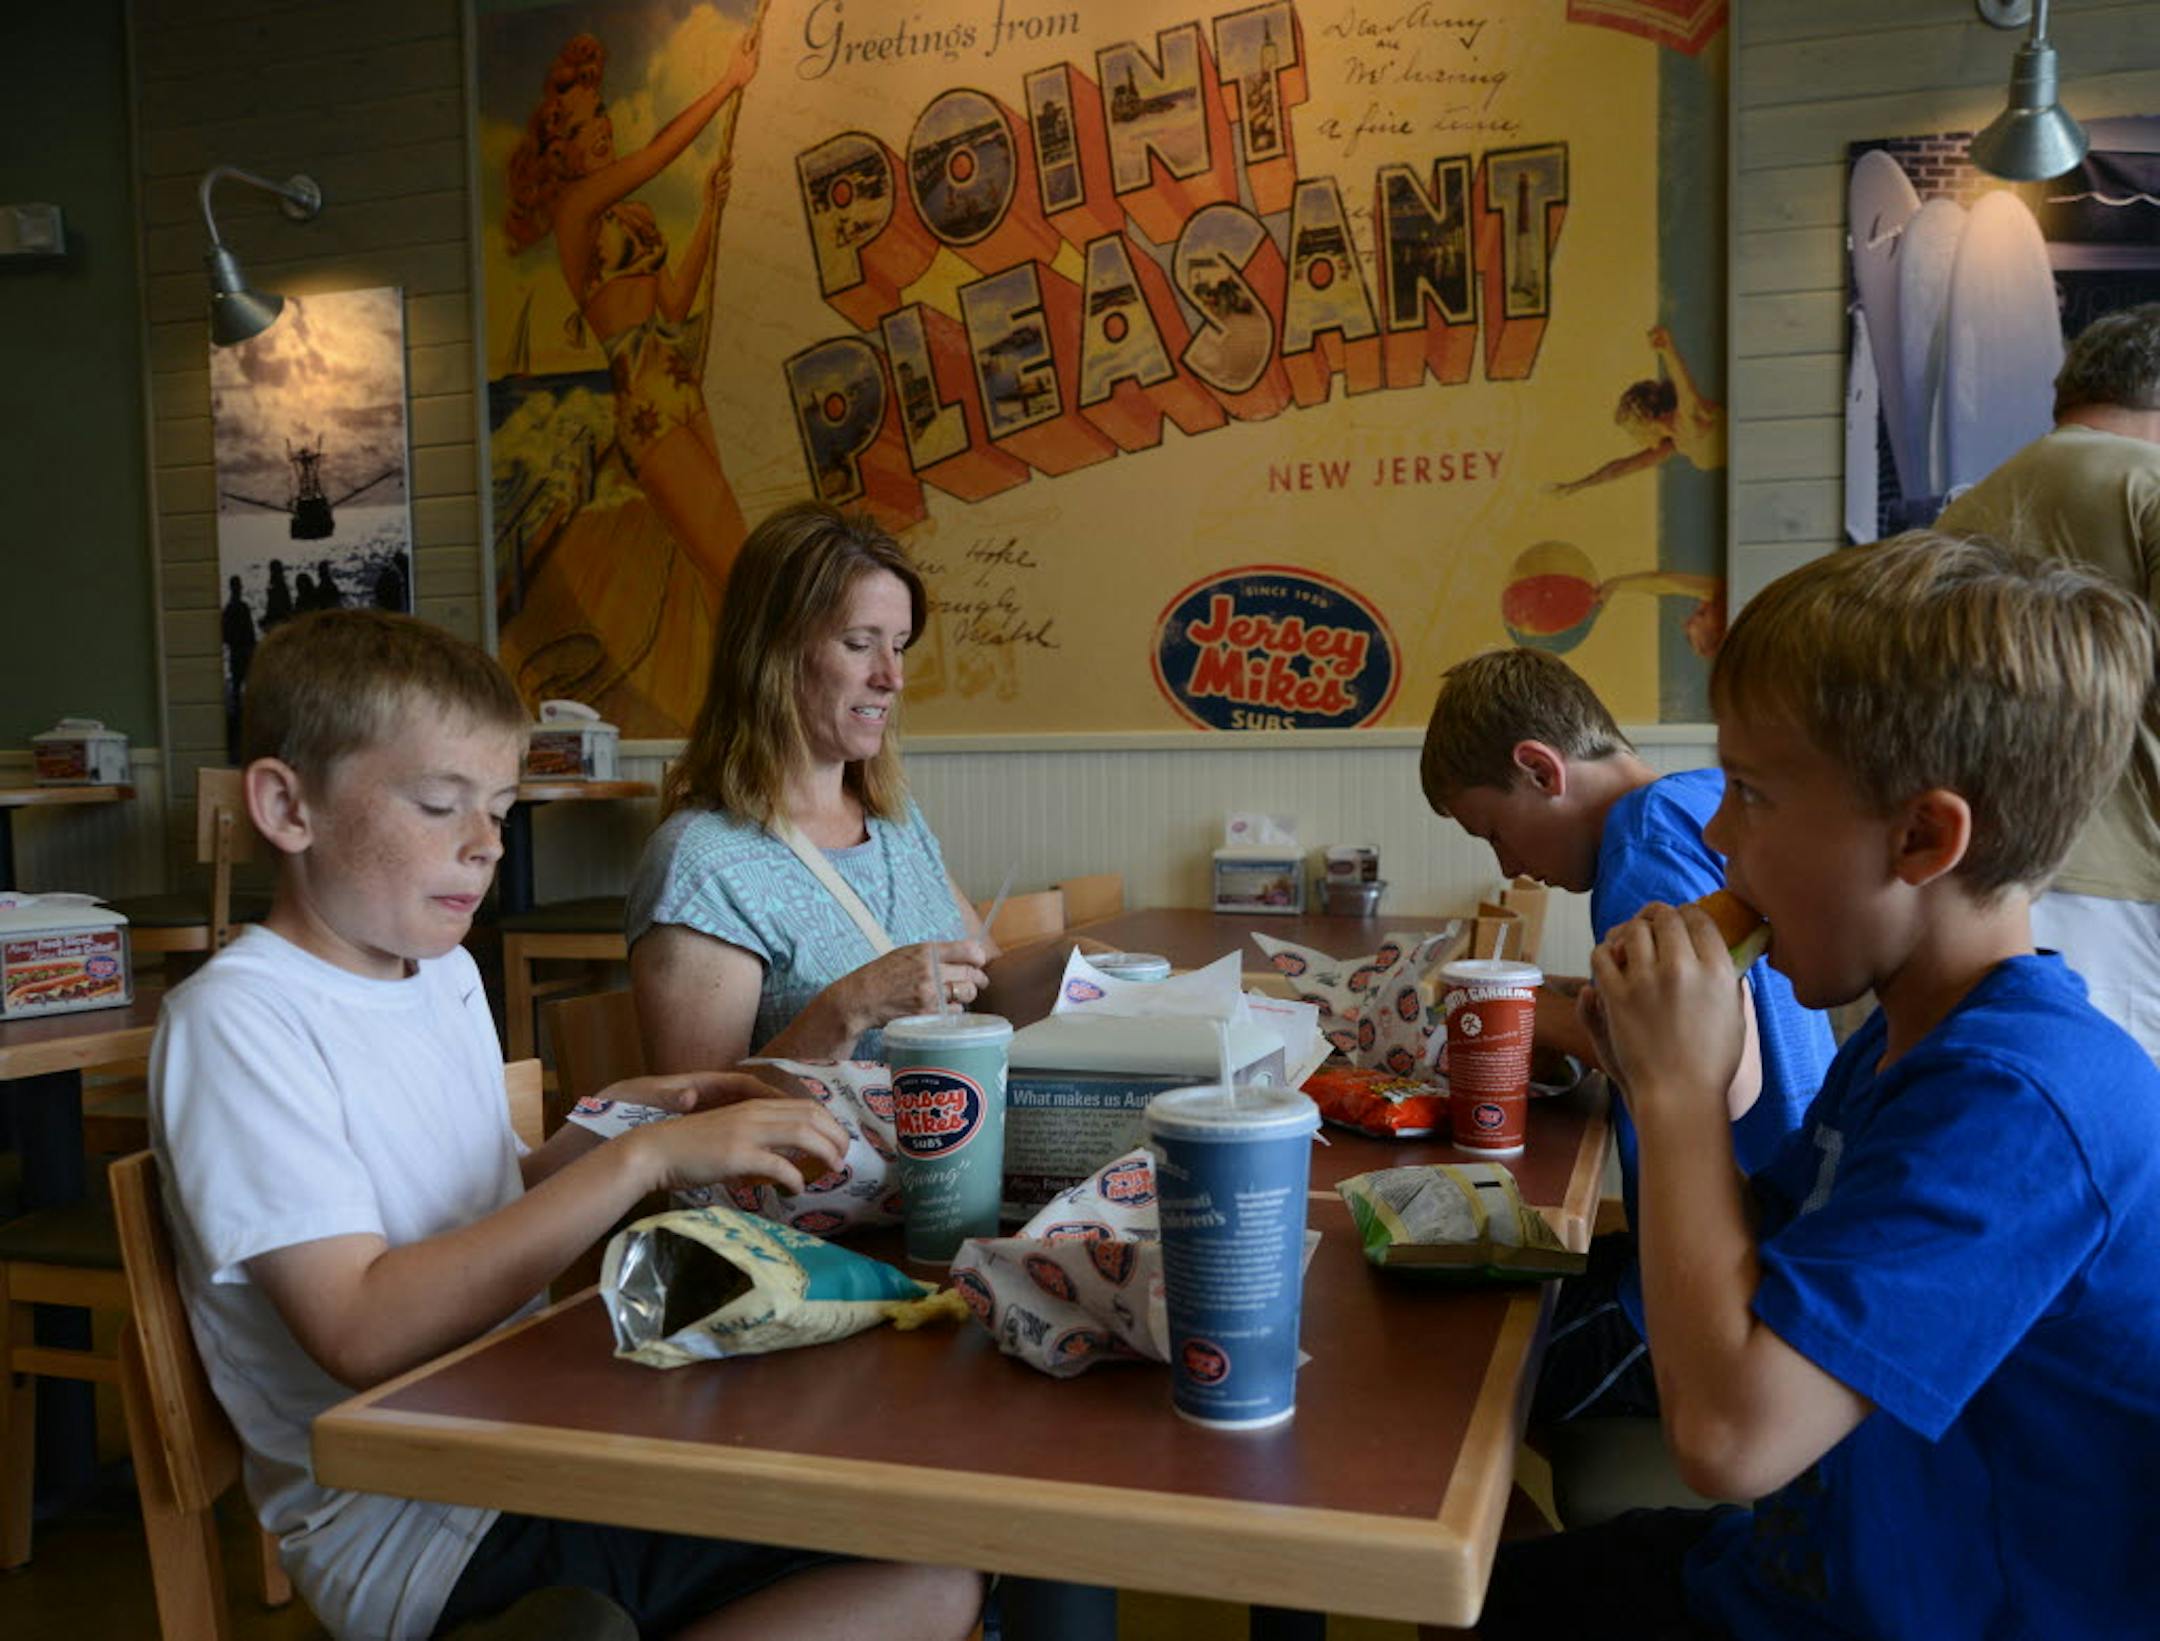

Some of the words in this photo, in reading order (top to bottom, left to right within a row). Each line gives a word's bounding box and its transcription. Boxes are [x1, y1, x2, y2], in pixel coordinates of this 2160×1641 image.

[795, 0, 977, 81] Greetings
[984, 0, 1080, 58] from
[794, 0, 1300, 300] POINT
[782, 141, 1570, 505] PLEASANT
[1267, 460, 1352, 494] NEW
[1372, 450, 1505, 488] JERSEY
[1246, 584, 1289, 599] SINCE
[1186, 593, 1370, 679] Jersey
[1187, 642, 1358, 717] Mike's
[1231, 709, 1298, 731] SUBS
[1012, 1088, 1052, 1106] What
[1053, 1089, 1101, 1107] makes
[1104, 1093, 1122, 1107] us
[895, 1108, 969, 1136] Mike's
[911, 1136, 944, 1150] SUBS
